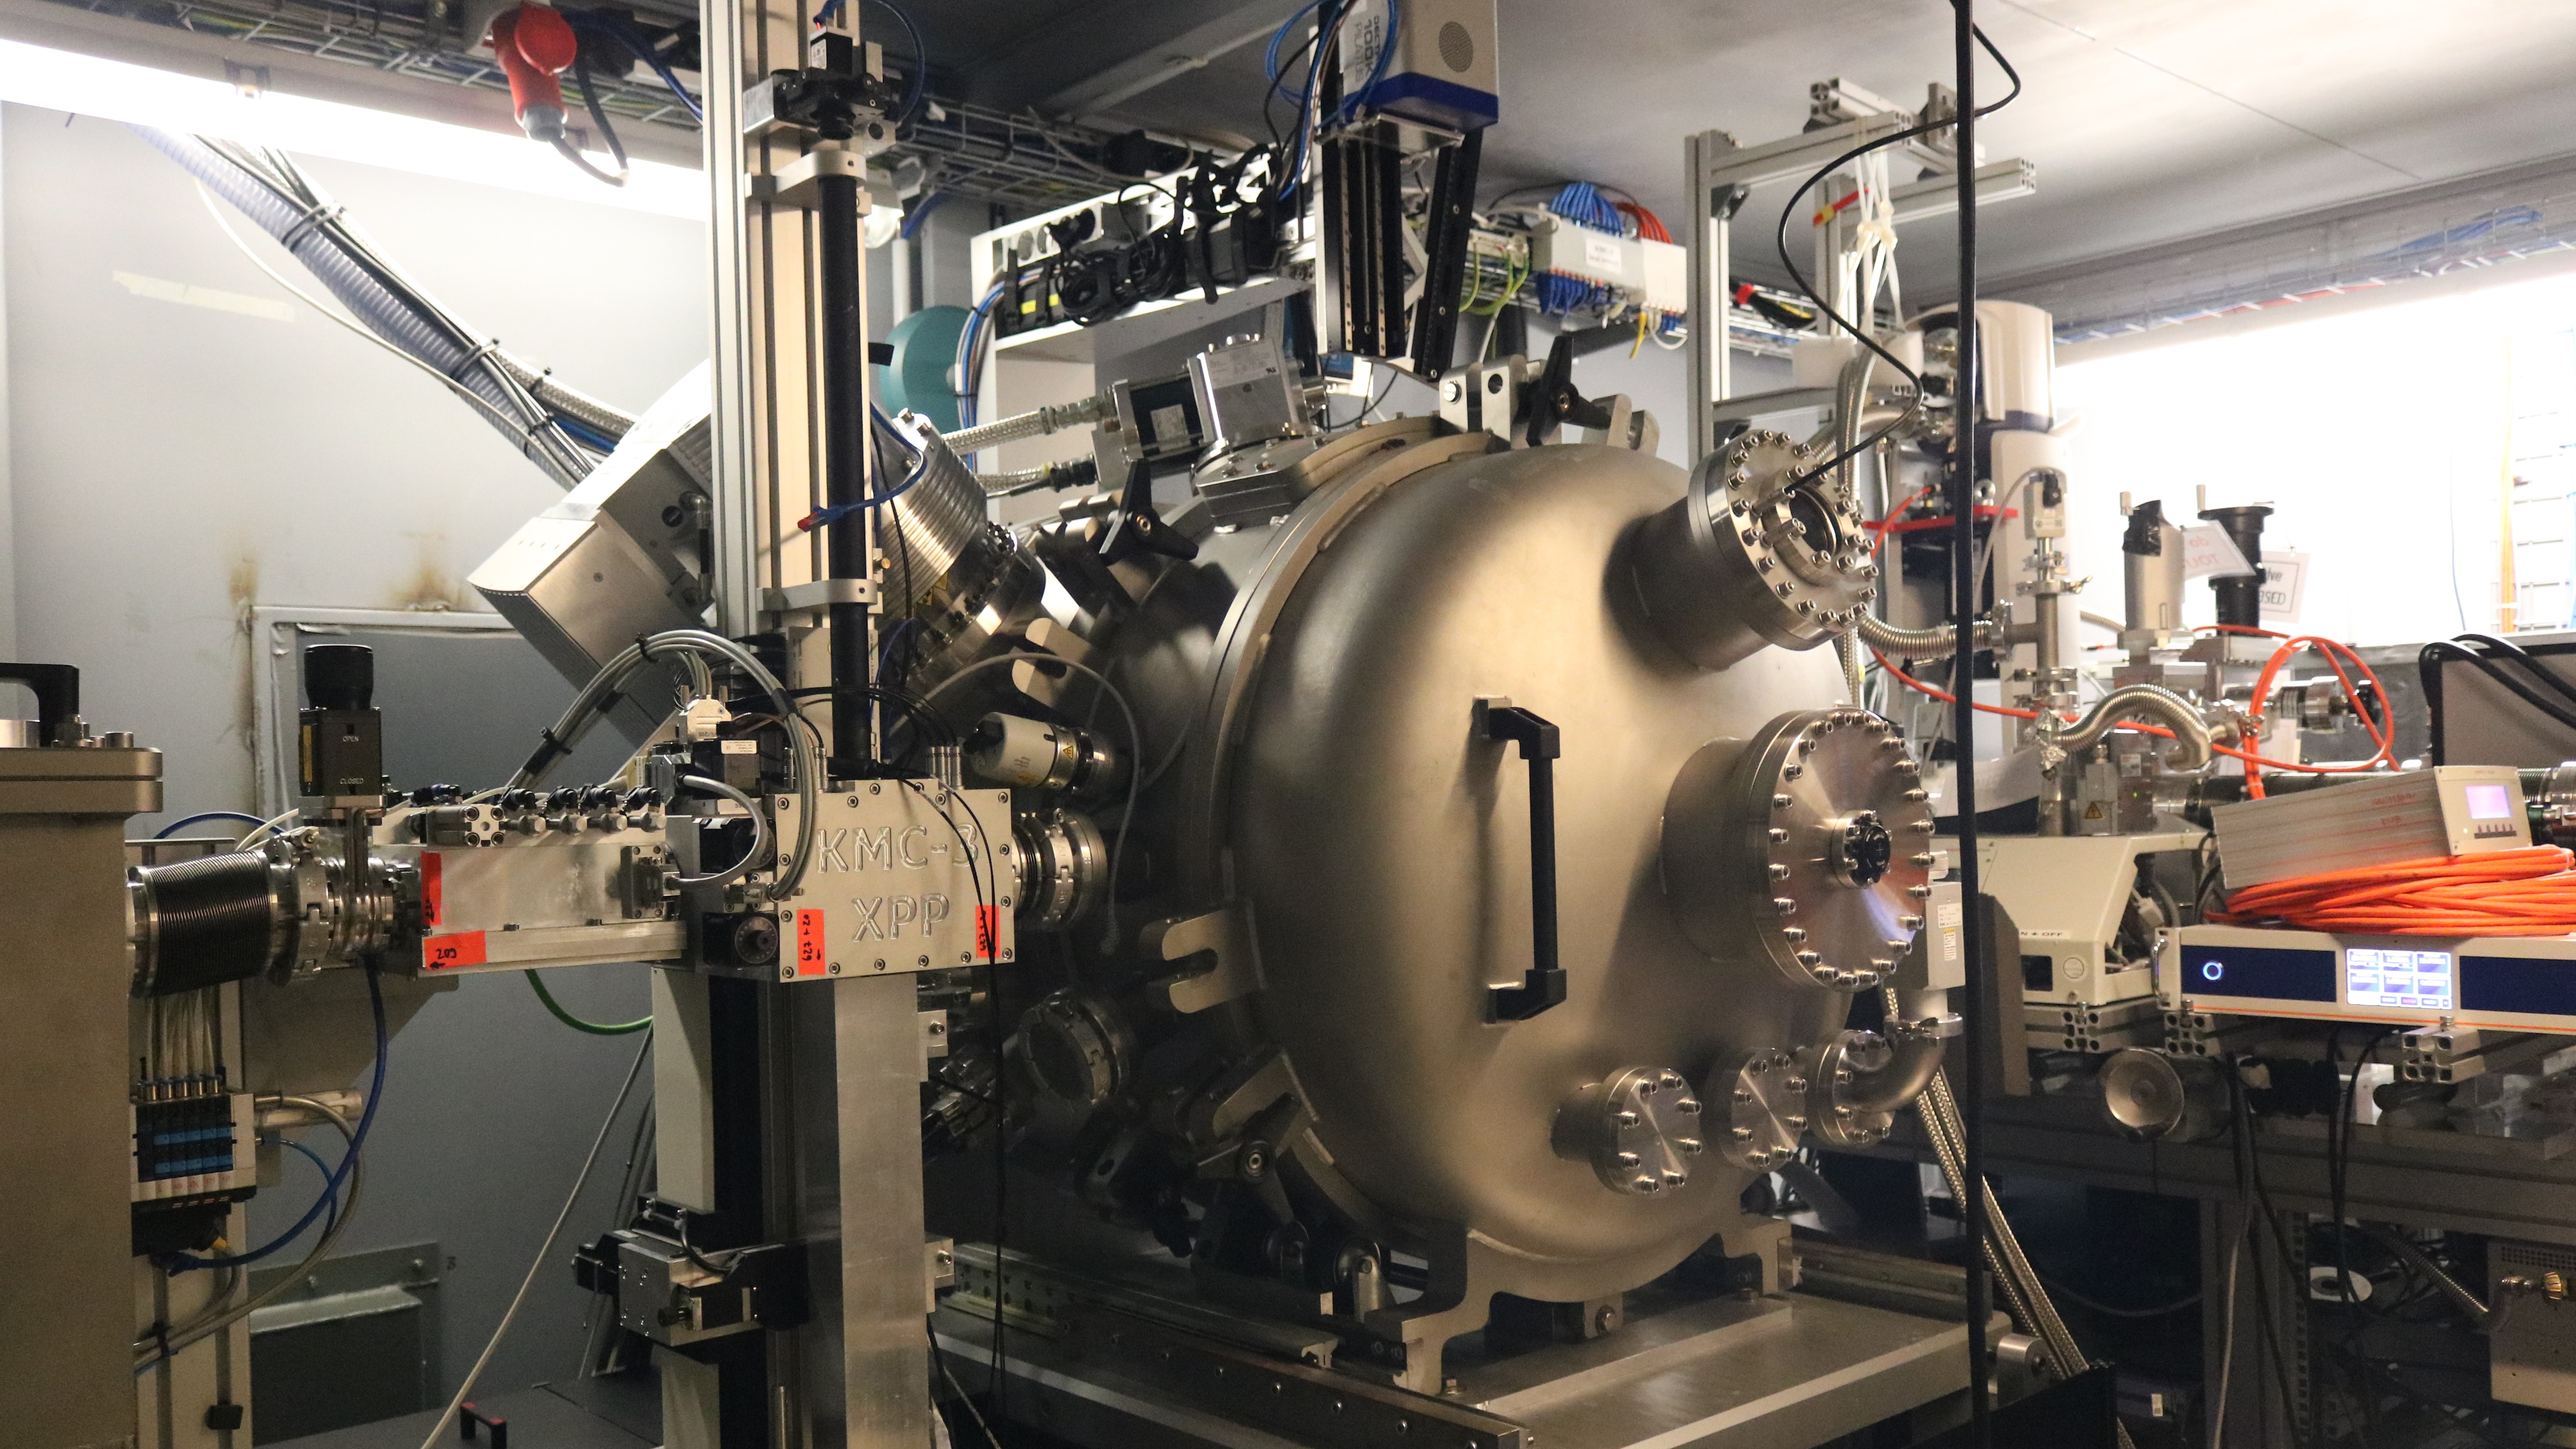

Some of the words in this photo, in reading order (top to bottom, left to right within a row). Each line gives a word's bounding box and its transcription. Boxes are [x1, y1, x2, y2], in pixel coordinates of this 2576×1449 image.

[1364, 18, 1373, 76] 100K
[2266, 566, 2283, 582] lve
[817, 823, 979, 873] KMC-3
[851, 893, 950, 942] XPP
